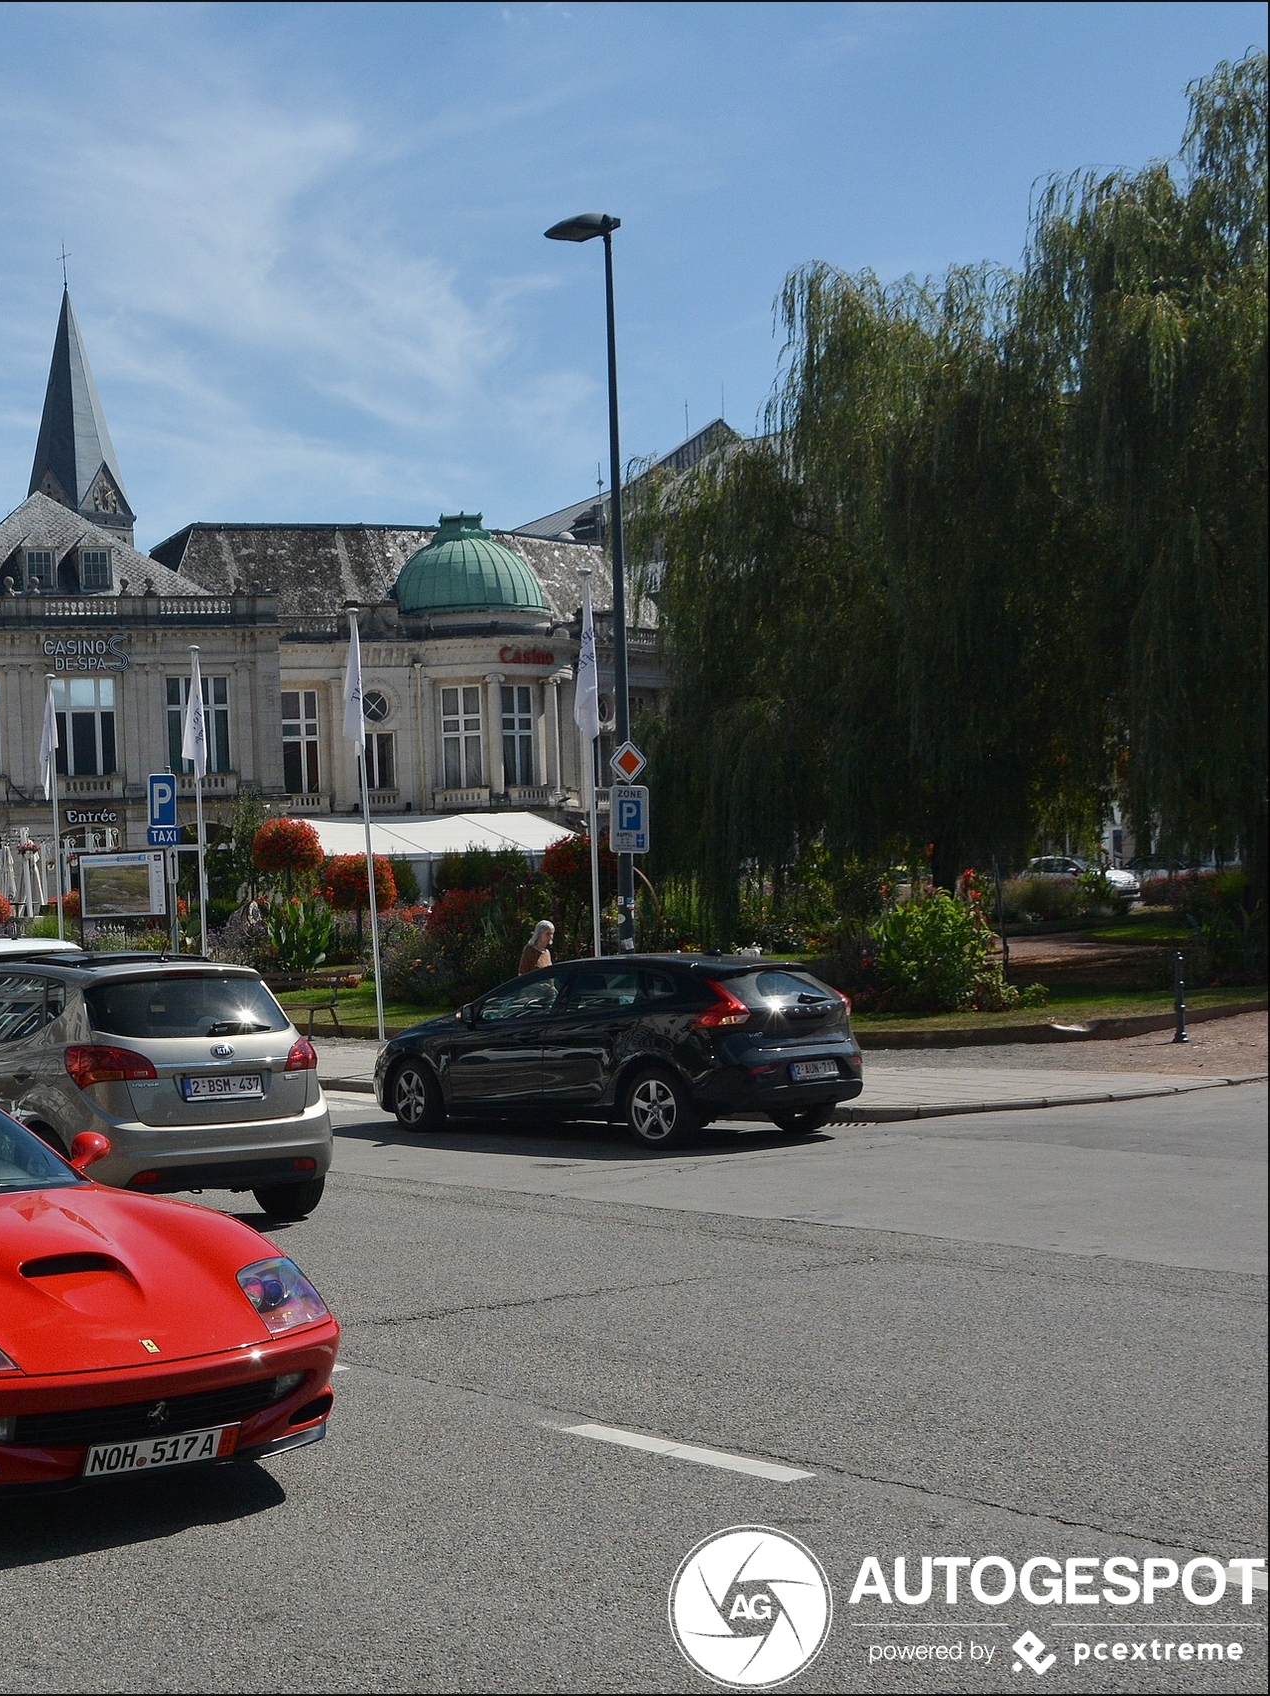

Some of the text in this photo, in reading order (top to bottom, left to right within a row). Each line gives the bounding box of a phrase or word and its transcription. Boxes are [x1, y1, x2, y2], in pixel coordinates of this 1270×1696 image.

[43, 640, 106, 655] CASINO
[499, 645, 555, 665] Casino
[55, 657, 107, 671] DE SPA
[153, 783, 172, 819] P
[617, 790, 642, 798] ZONE
[65, 808, 118, 823] Entrée
[622, 802, 637, 828] P
[151, 830, 177, 842] TAXI
[217, 1046, 233, 1055] KIA
[192, 1077, 260, 1094] 2-BSM-437
[90, 1444, 138, 1473] NOH
